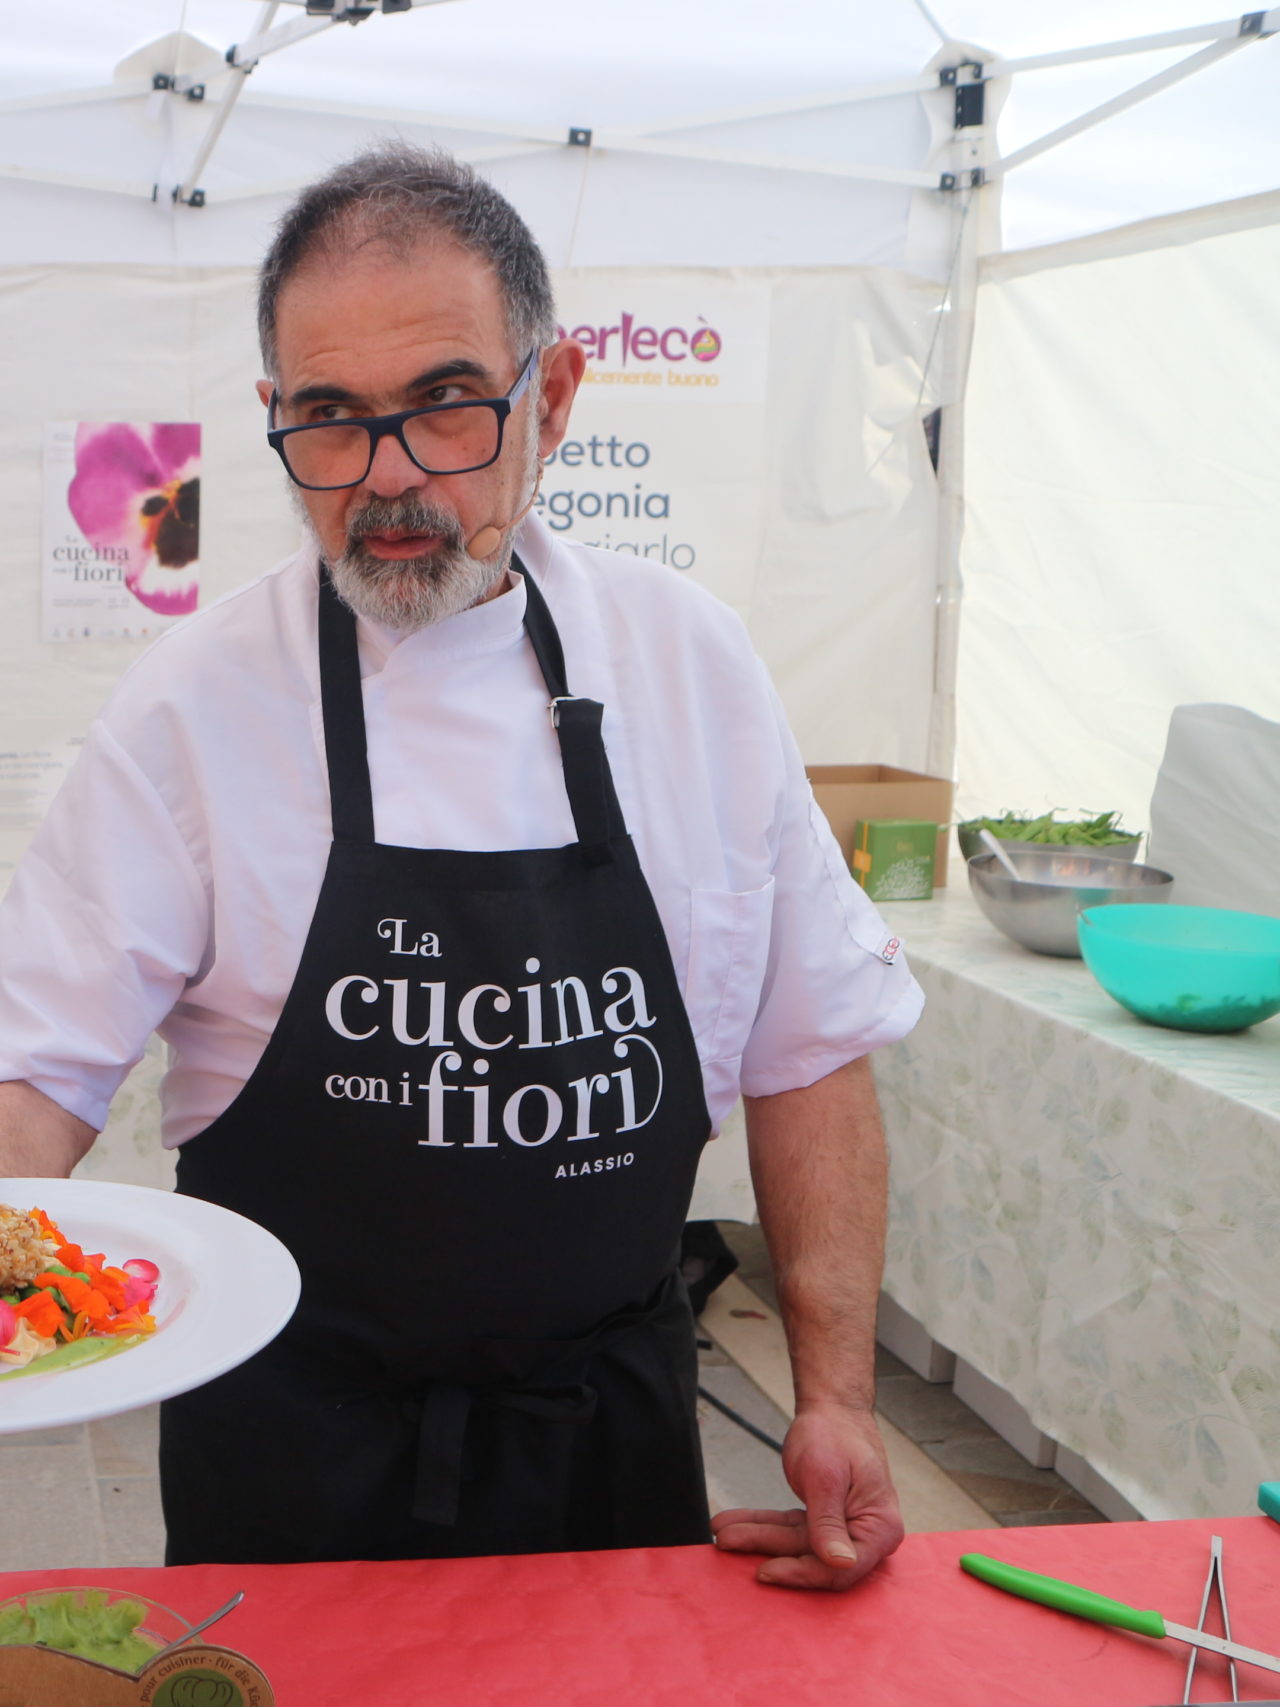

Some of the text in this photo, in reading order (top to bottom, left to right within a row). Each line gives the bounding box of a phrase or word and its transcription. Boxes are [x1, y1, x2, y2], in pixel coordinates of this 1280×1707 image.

[557, 311, 722, 368] erlecò
[668, 369, 719, 387] buono
[534, 483, 671, 532] egonia
[52, 541, 129, 562] cucina
[74, 560, 125, 582] fiori
[377, 918, 443, 958] La
[325, 957, 657, 1050] cucina
[325, 1071, 413, 1106] con i
[418, 1034, 663, 1148] fiori
[554, 1152, 635, 1178] ALASSIO
[140, 1677, 159, 1703] pour
[158, 1656, 207, 1678] cuisiner
[216, 1656, 236, 1671] für
[234, 1669, 251, 1686] die
